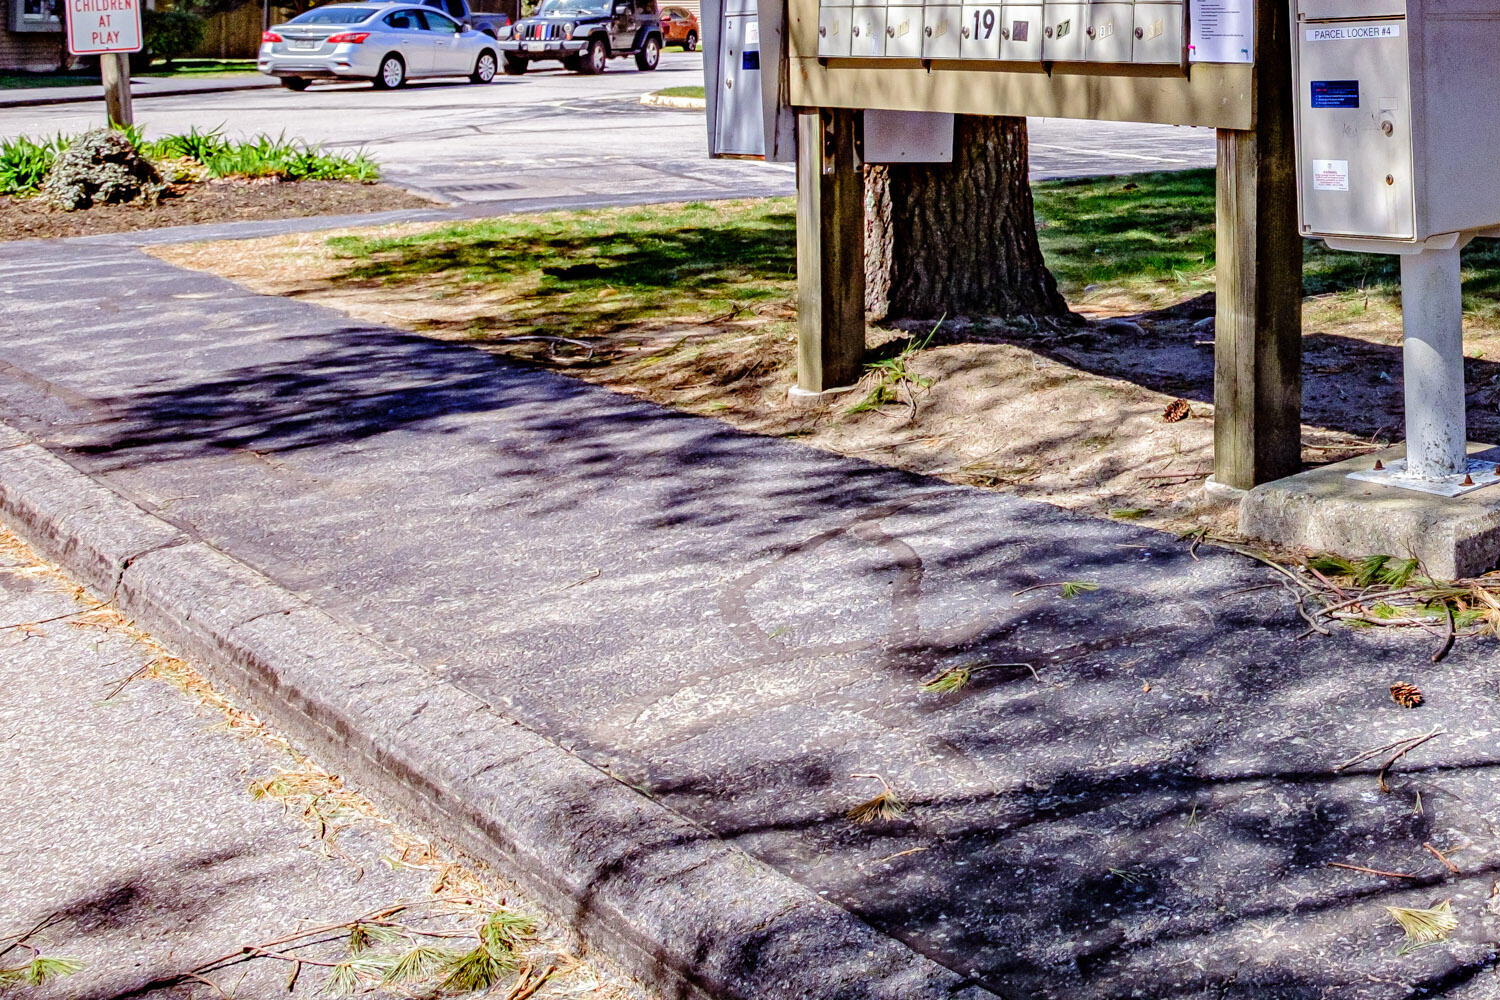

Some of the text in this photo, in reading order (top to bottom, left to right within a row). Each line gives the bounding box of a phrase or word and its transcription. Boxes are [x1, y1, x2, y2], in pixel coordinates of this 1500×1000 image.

[98, 14, 111, 28] AT
[973, 8, 995, 40] 19
[1056, 20, 1070, 38] 27
[1314, 27, 1391, 40] PARCEL LOCKER #4
[91, 30, 121, 45] PLAY
